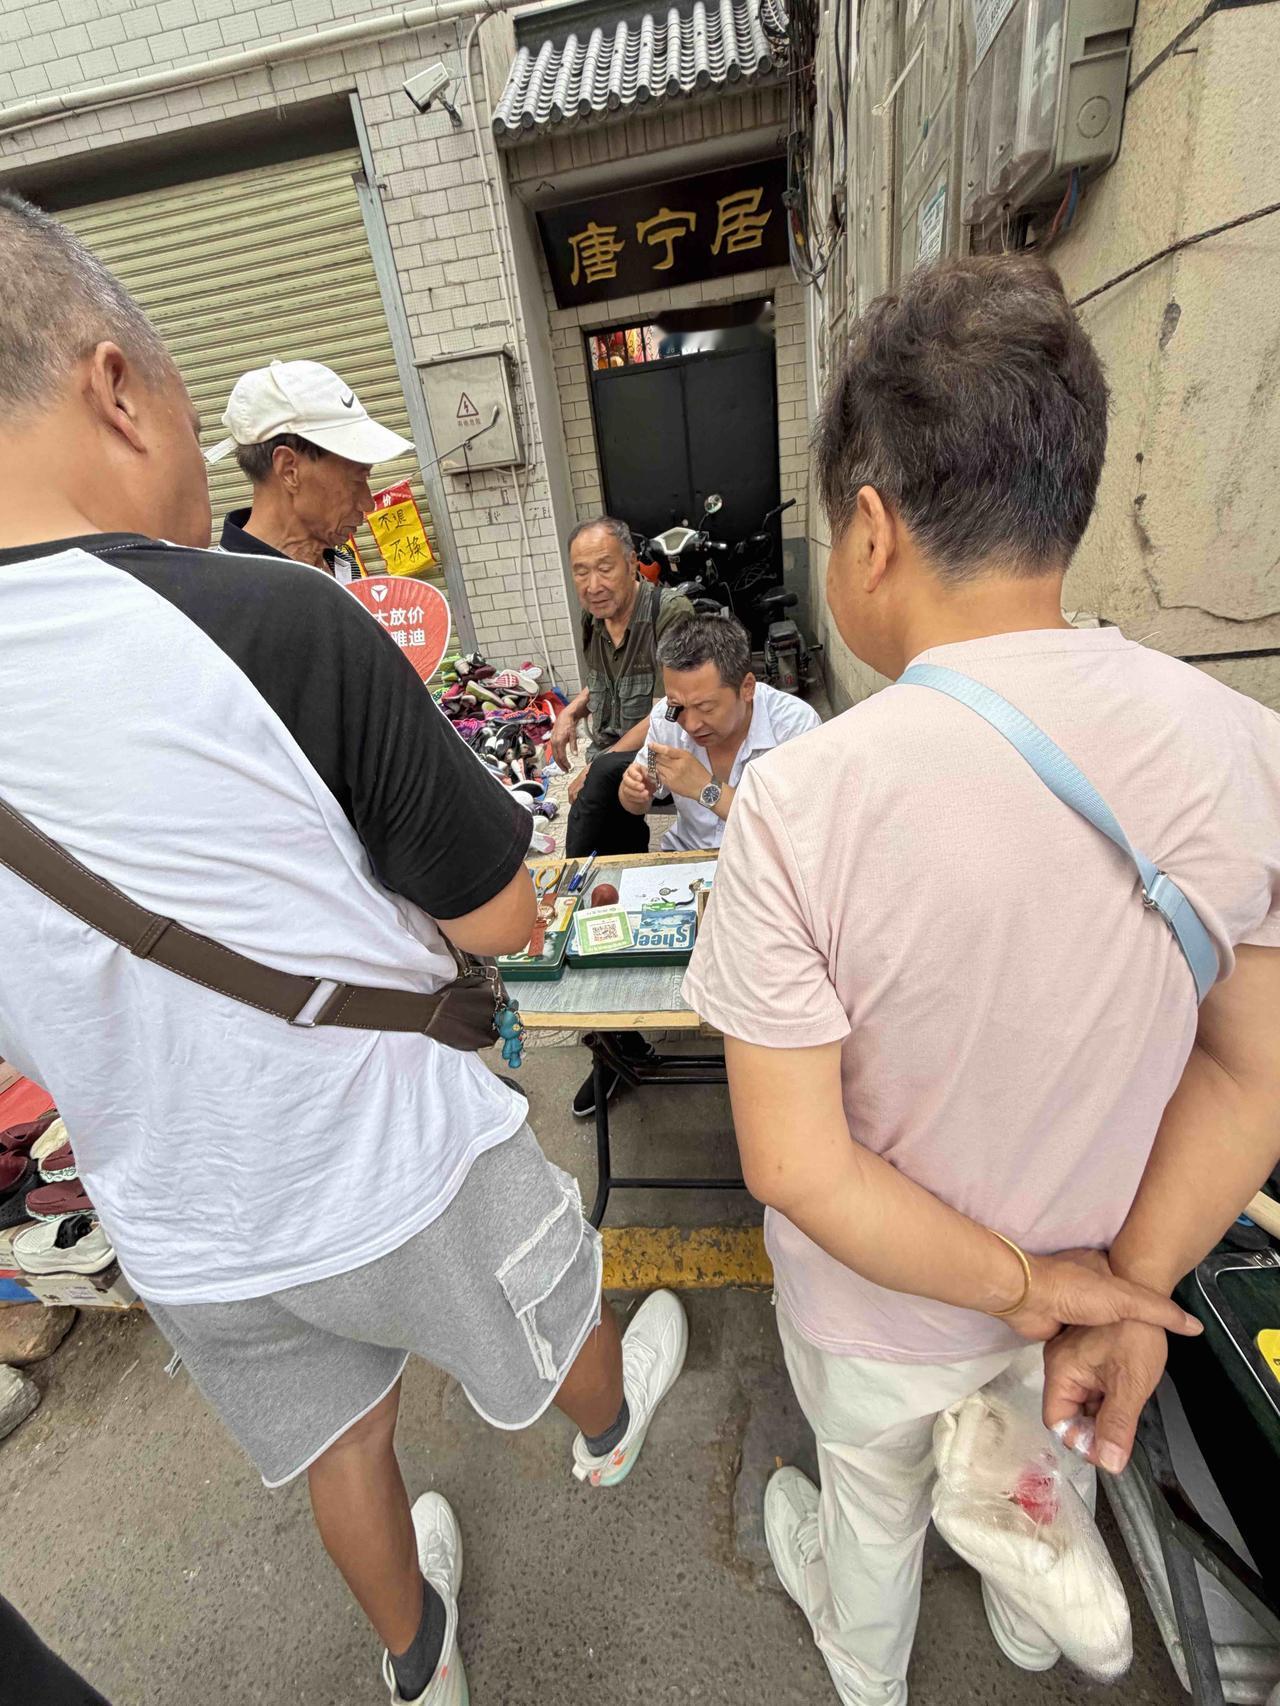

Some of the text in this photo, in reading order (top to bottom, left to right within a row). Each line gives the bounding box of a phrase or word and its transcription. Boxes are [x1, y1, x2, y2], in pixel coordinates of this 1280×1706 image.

[567, 187, 772, 286] 唐宁居
[378, 508, 414, 532] 不退
[389, 536, 429, 563] 不换
[373, 606, 425, 626] 大放价
